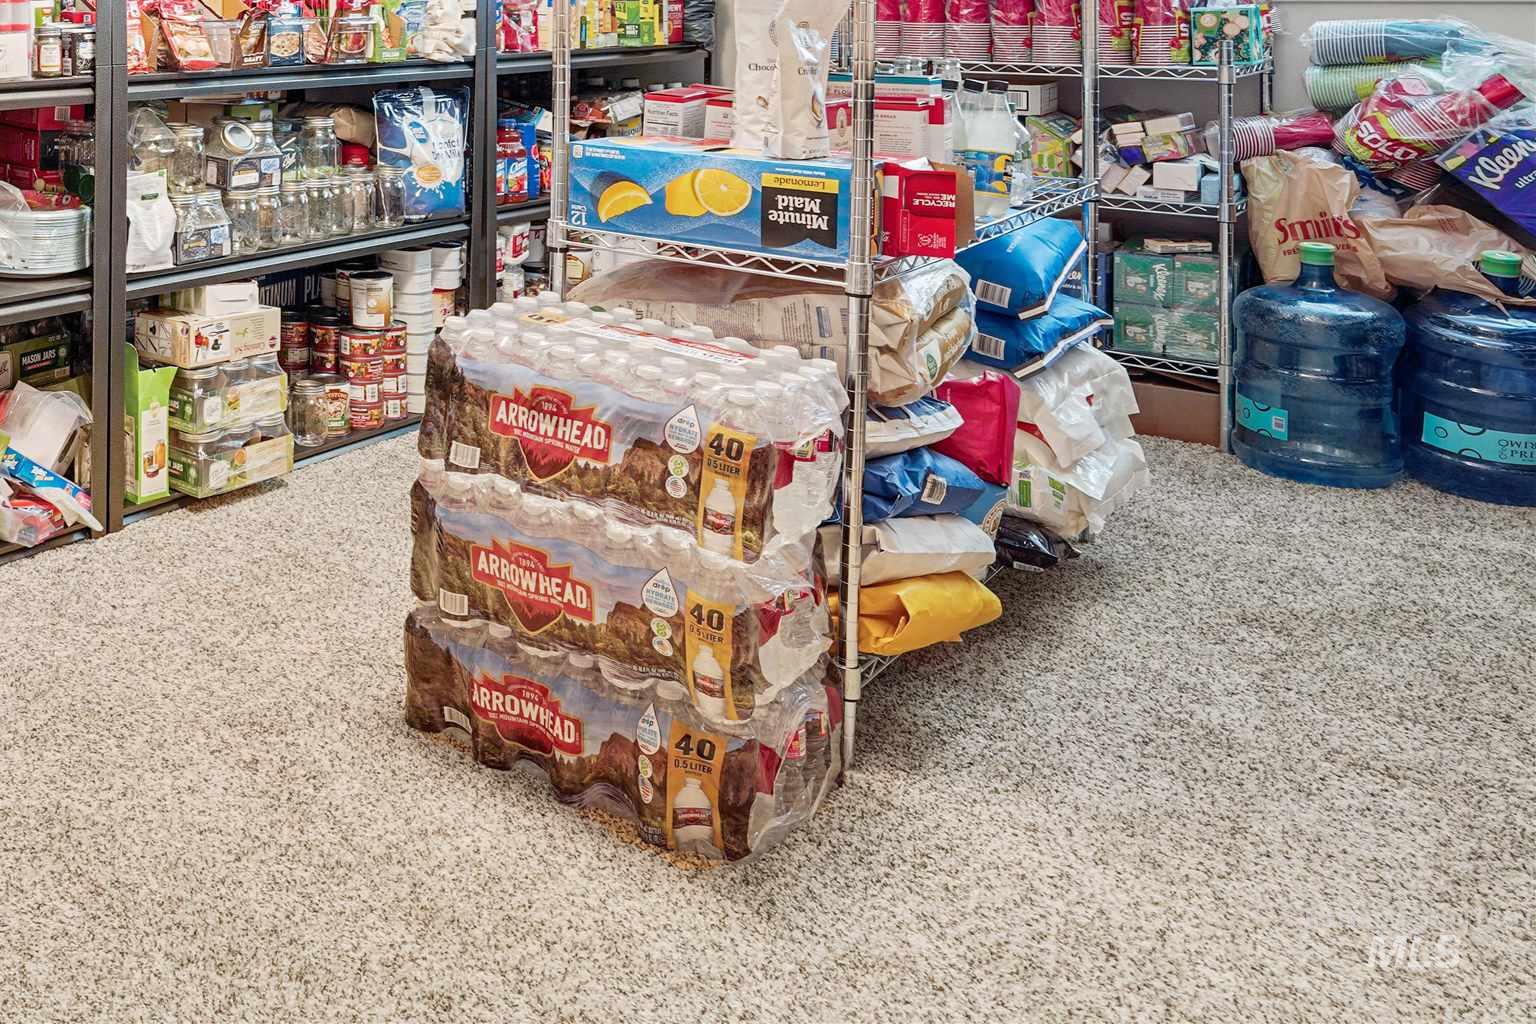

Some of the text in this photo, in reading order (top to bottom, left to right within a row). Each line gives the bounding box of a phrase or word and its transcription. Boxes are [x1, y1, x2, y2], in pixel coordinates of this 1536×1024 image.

[1357, 120, 1417, 161] SOLO
[1468, 139, 1536, 190] Kleen
[773, 176, 825, 190] Lemonade
[777, 194, 822, 213] Maid
[913, 199, 955, 208] RECYCLE
[571, 209, 588, 226] 12
[768, 210, 829, 231] Minute
[22, 349, 56, 365] MASON JARS
[495, 399, 607, 451] ARROWHEAD
[708, 432, 745, 462] 40
[707, 459, 740, 476] 0.5 LITER
[518, 557, 536, 569] 1894
[478, 550, 587, 609] ARROWHEAD
[690, 603, 725, 631] 40
[702, 630, 724, 644] LITER
[522, 689, 539, 703] 1894
[472, 683, 576, 744] ARROWHEAD
[499, 713, 528, 725] MOUNTAIN
[675, 733, 716, 762] 40
[674, 758, 713, 775] 0.5 LITER
